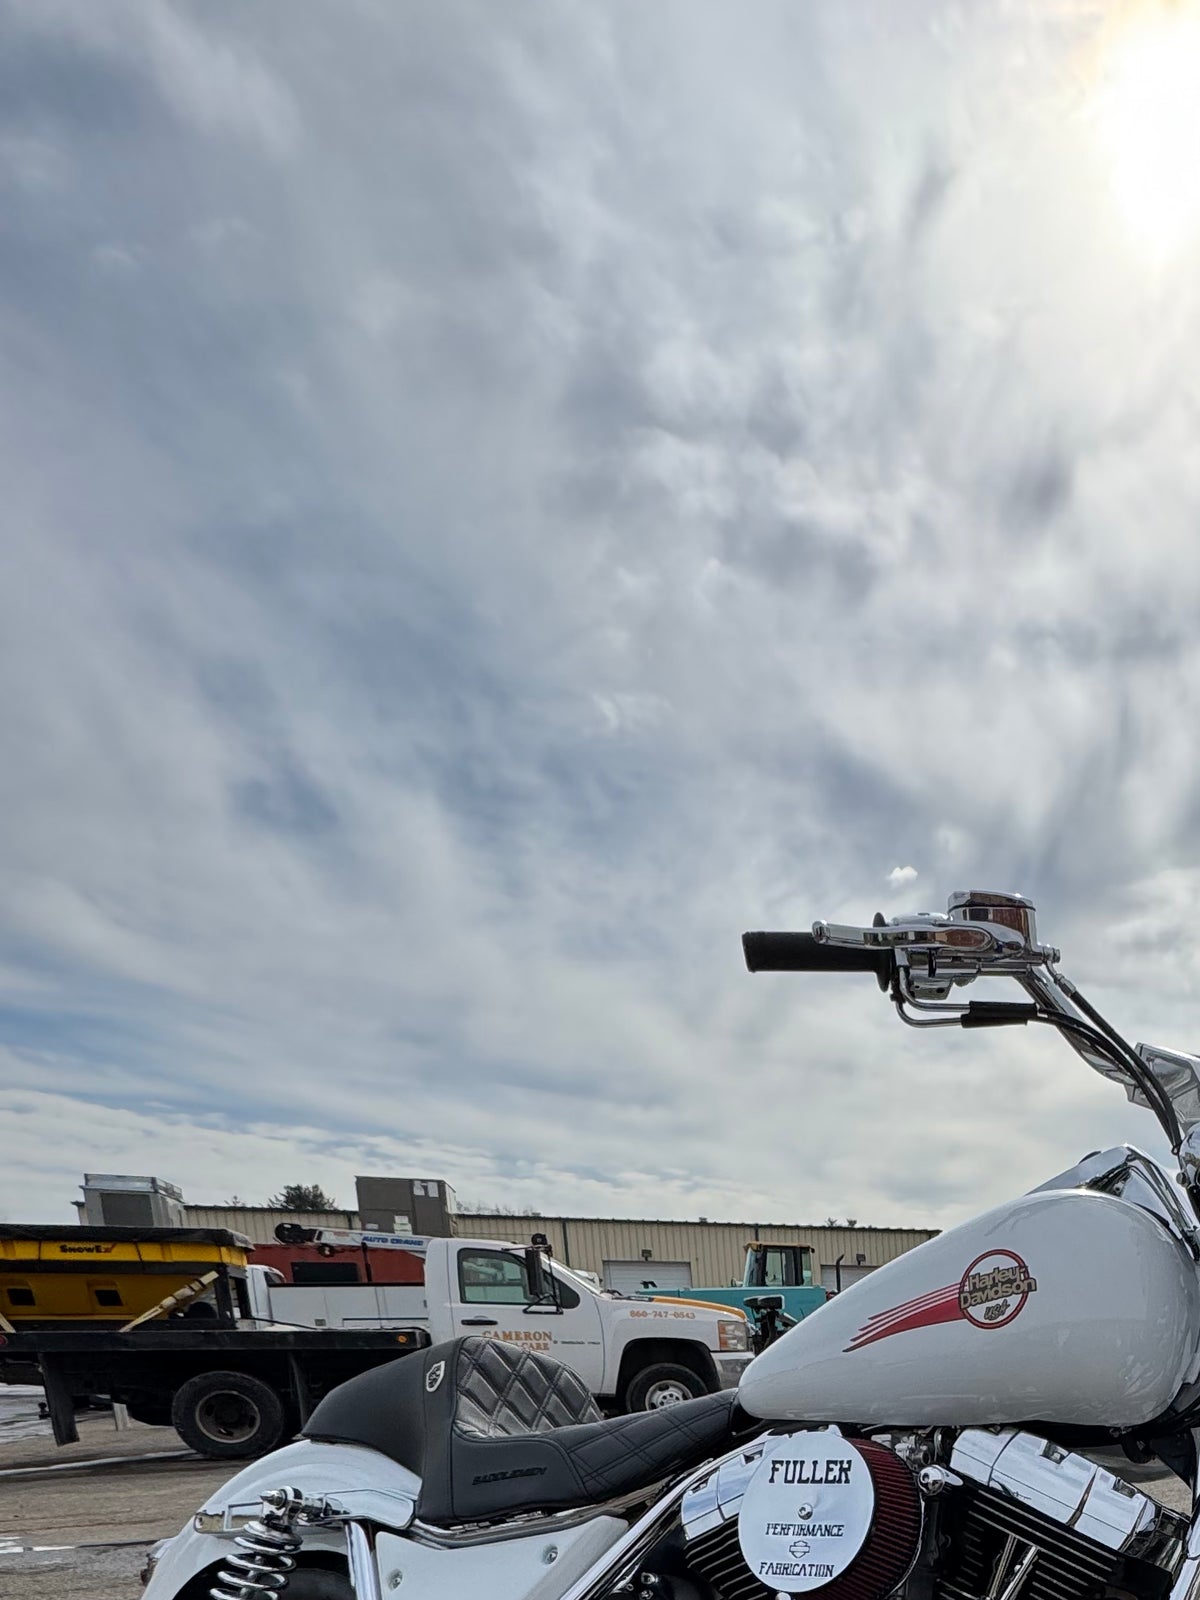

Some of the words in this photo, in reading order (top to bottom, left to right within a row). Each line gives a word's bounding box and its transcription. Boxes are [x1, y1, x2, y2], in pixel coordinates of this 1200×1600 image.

[390, 1238, 424, 1246] CRANE
[959, 1277, 1037, 1310] Davidson
[482, 1331, 553, 1341] CAMERON
[521, 1342, 550, 1351] CARE
[769, 1460, 852, 1484] FULLER
[765, 1523, 845, 1537] PERFORMANCE
[759, 1562, 835, 1577] FABRICATION
